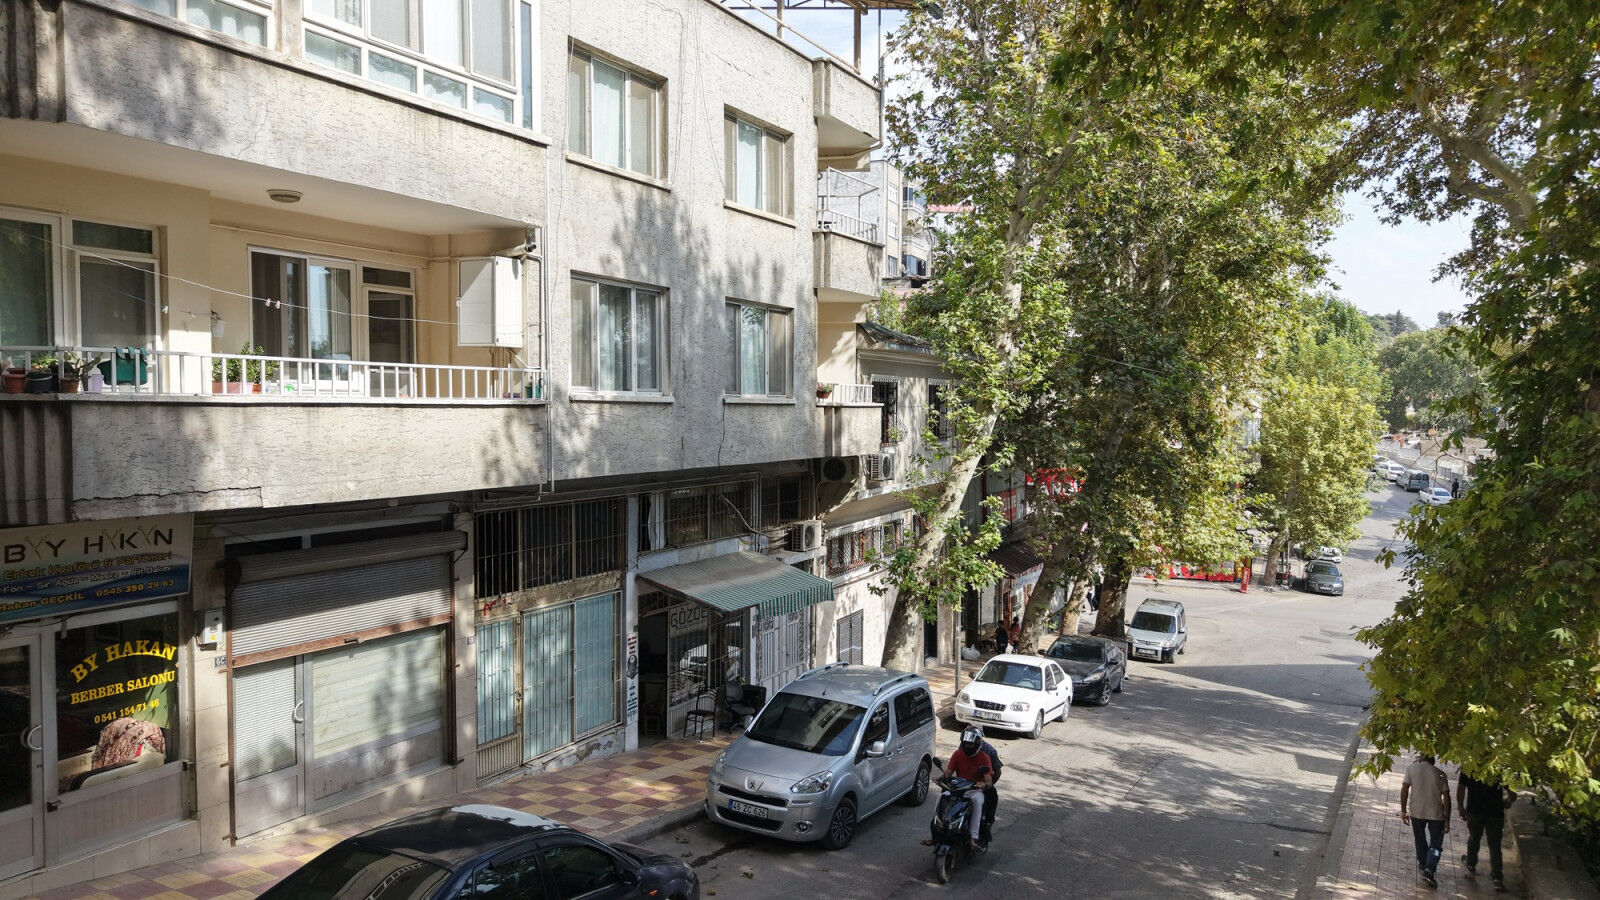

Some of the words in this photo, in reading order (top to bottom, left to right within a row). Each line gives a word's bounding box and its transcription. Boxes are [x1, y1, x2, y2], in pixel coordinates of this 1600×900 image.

[4, 566, 43, 580] Erkek
[48, 559, 100, 575] Kuaförü
[70, 652, 99, 683] BY
[105, 639, 177, 663] HAKAN
[70, 683, 124, 705] BERBER
[127, 671, 176, 691] SALONU
[101, 711, 117, 722] 541
[119, 706, 135, 717] 154
[136, 703, 147, 712] 71
